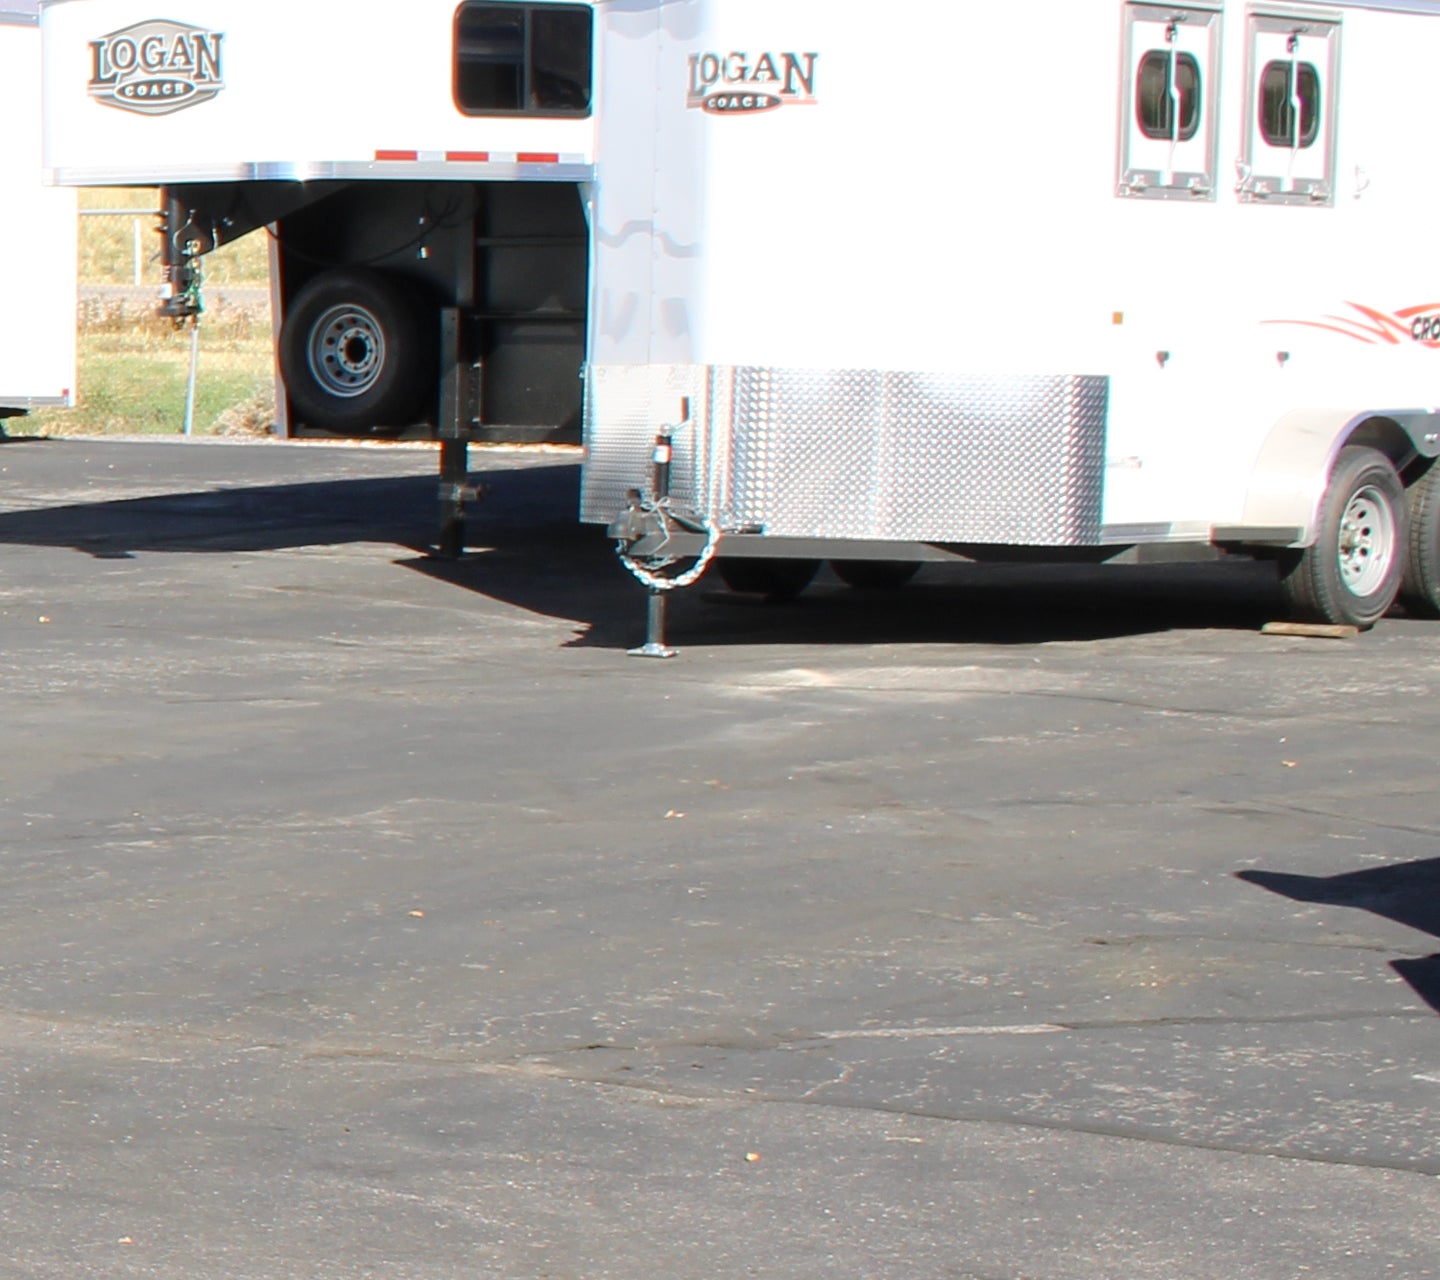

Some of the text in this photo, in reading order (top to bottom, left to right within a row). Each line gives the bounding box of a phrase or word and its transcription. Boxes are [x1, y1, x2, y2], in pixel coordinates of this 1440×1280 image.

[88, 32, 224, 84] LOGAN
[688, 51, 818, 96] LOGAN
[124, 83, 185, 96] COACH
[707, 96, 769, 108] COACH
